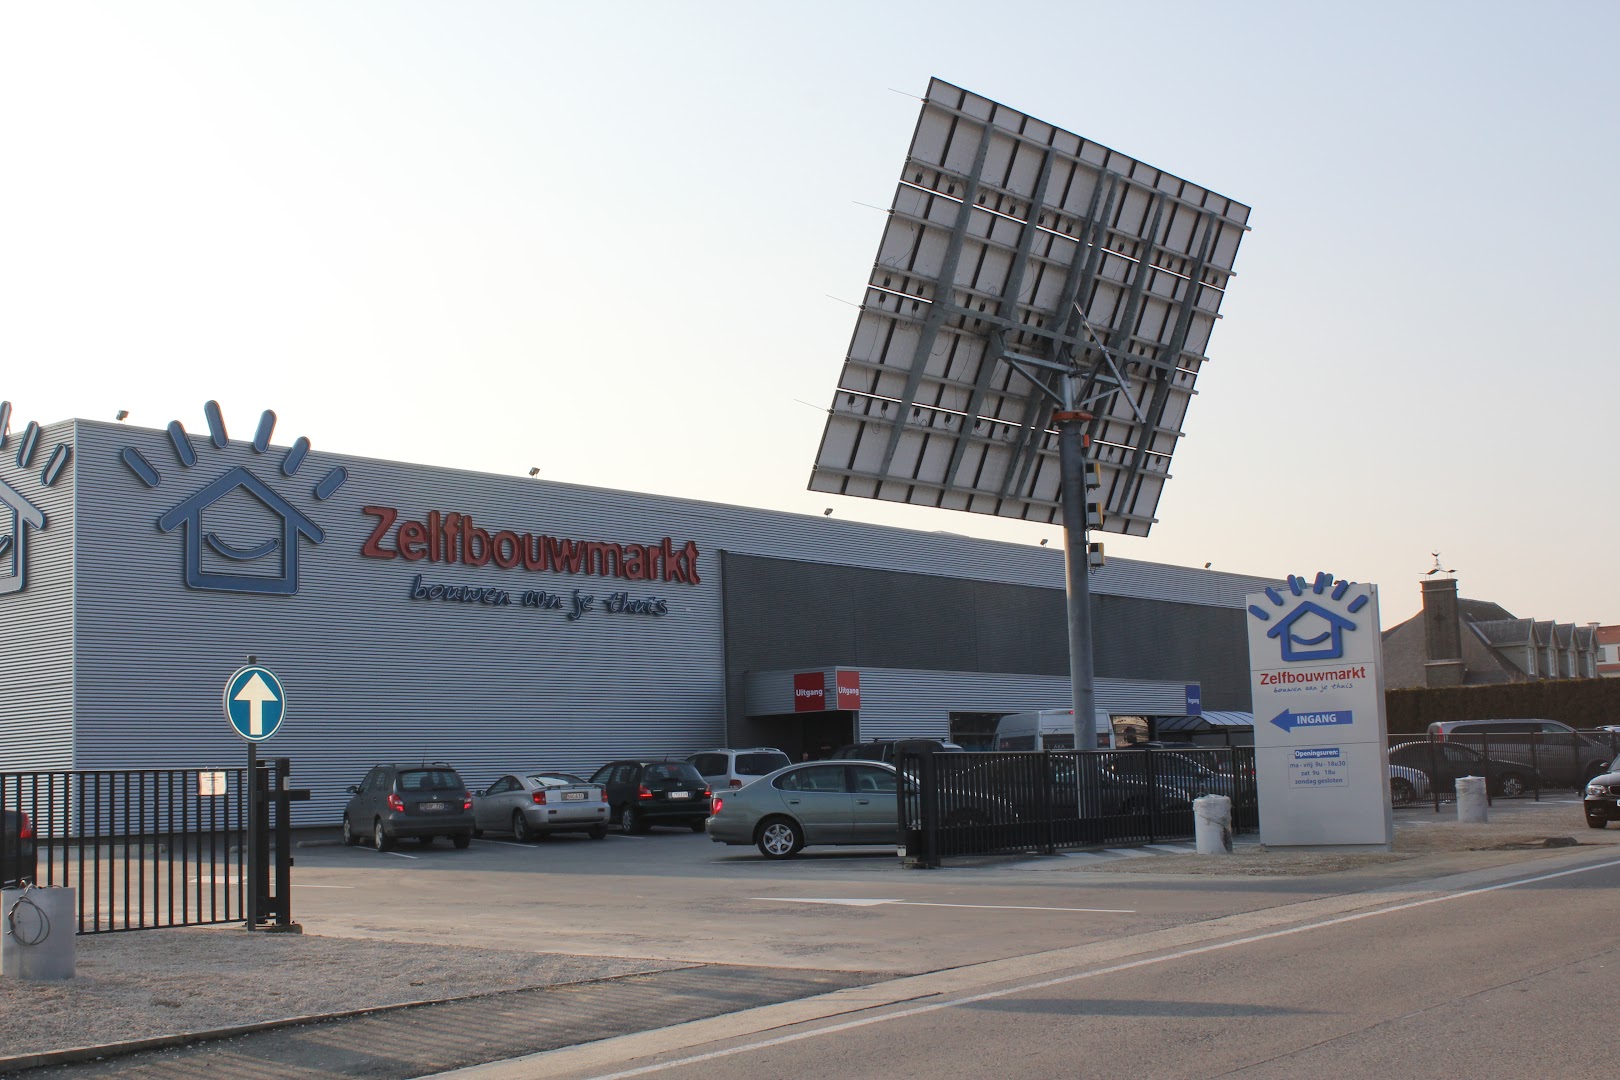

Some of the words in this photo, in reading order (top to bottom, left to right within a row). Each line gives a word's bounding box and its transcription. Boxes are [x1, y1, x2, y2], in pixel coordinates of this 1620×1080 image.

[361, 505, 701, 584] Zelfbouwmarkt
[410, 574, 512, 607] bouwen
[521, 589, 564, 610] aan
[567, 589, 595, 620] je
[604, 592, 669, 617] thuis
[1260, 666, 1366, 686] Zelfbouwmarkt
[838, 686, 859, 696] Uitgang
[1319, 684, 1328, 692] je
[1332, 682, 1354, 690] thuis
[796, 689, 823, 697] Uitgang
[1296, 714, 1337, 724] INGANG
[1303, 761, 1313, 769] vrij
